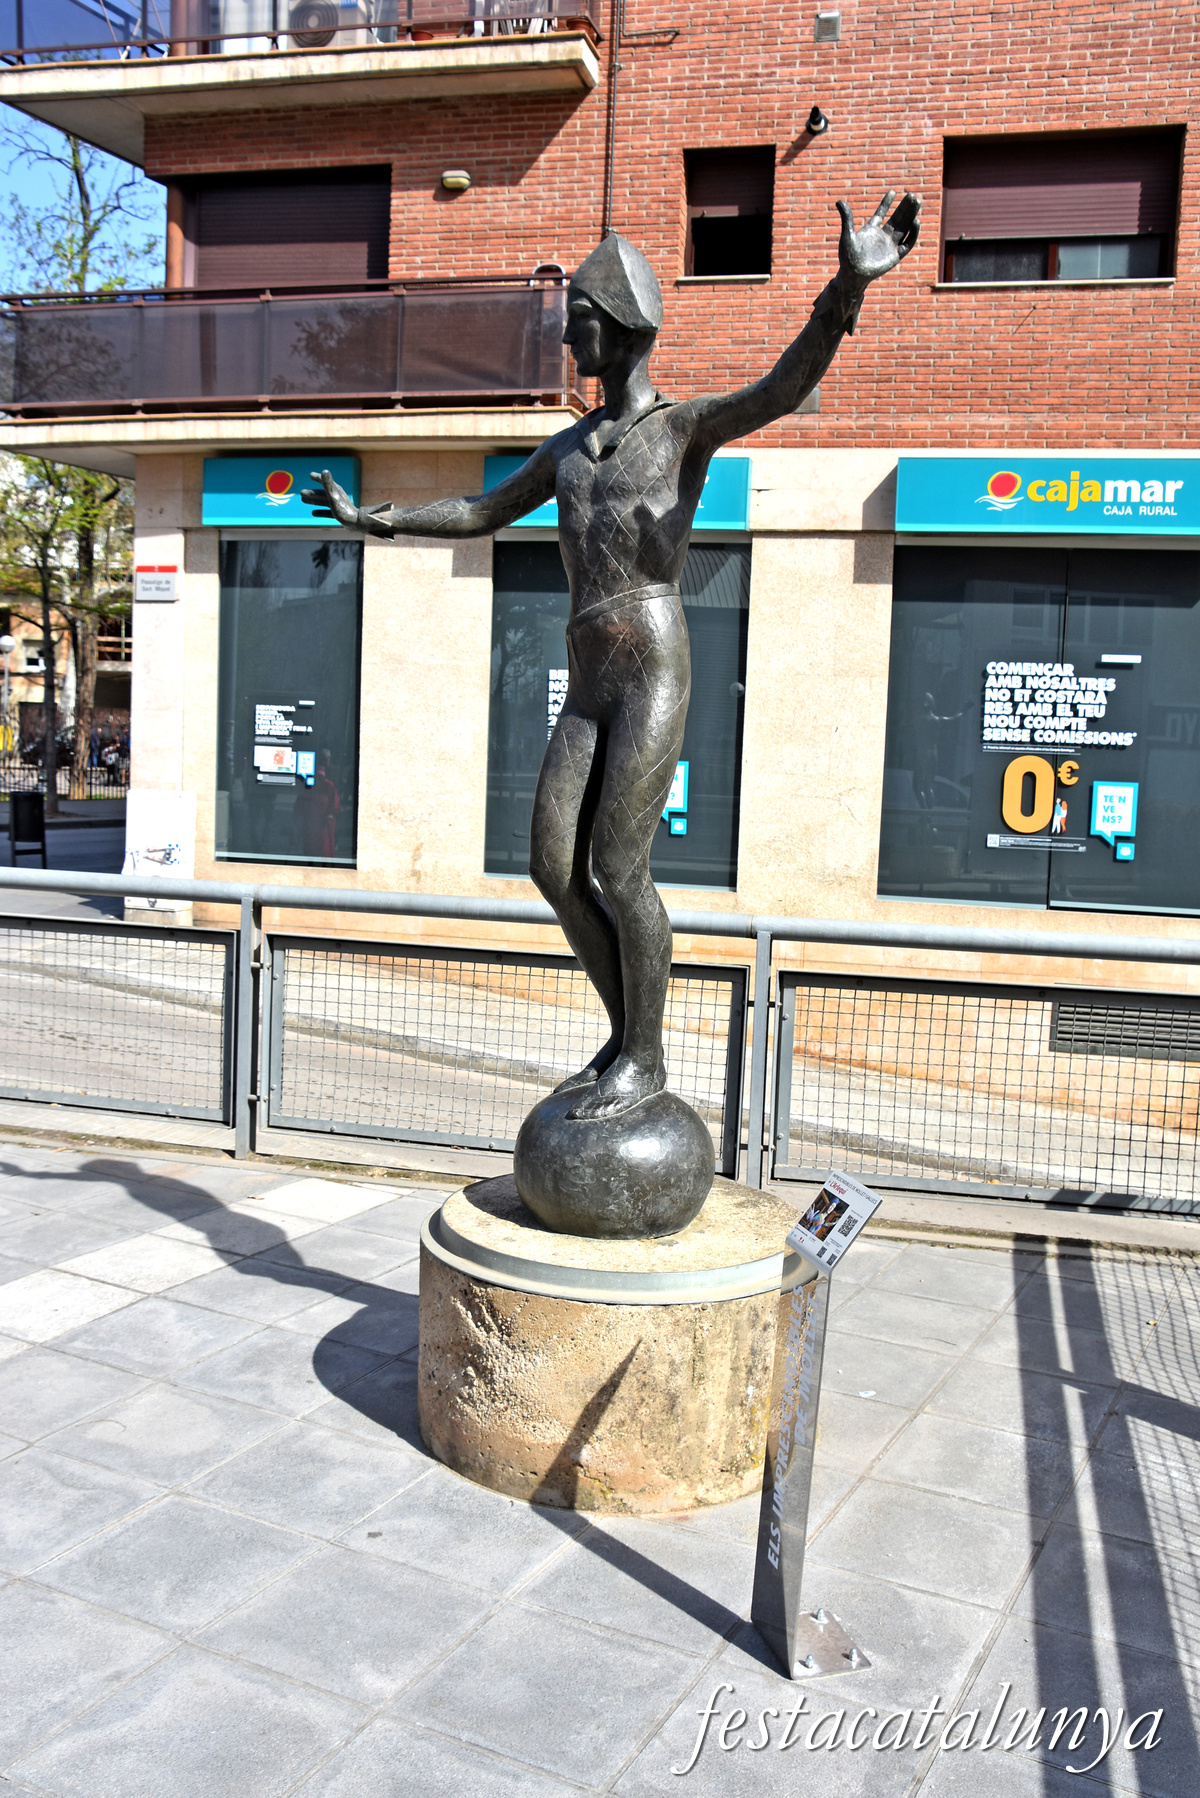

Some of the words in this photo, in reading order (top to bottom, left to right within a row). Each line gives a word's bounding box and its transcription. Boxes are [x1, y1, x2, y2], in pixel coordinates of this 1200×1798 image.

[1026, 470, 1184, 512] cajamar
[1103, 505, 1133, 516] CAJA
[1139, 505, 1178, 516] RURAL
[986, 661, 1075, 679] COMENÇAR
[985, 675, 1023, 689] AMB
[1026, 676, 1117, 692] NOSALTRES
[984, 688, 1011, 702] NO
[1013, 689, 1032, 702] ET
[984, 701, 1013, 715] RES
[1016, 702, 1053, 716] AMB
[1056, 703, 1074, 717] EL
[1076, 704, 1106, 718] TEU
[983, 714, 1021, 728] NOU
[1023, 715, 1087, 731] COMPTE
[982, 728, 1031, 742] SENSE
[1103, 805, 1115, 813] VE
[1102, 815, 1123, 824] NS?
[799, 1291, 819, 1402] MOLLET
[771, 1281, 805, 1519] IMPRESCINDIBLES
[794, 1405, 808, 1446] DE
[767, 1520, 782, 1570] ELS
